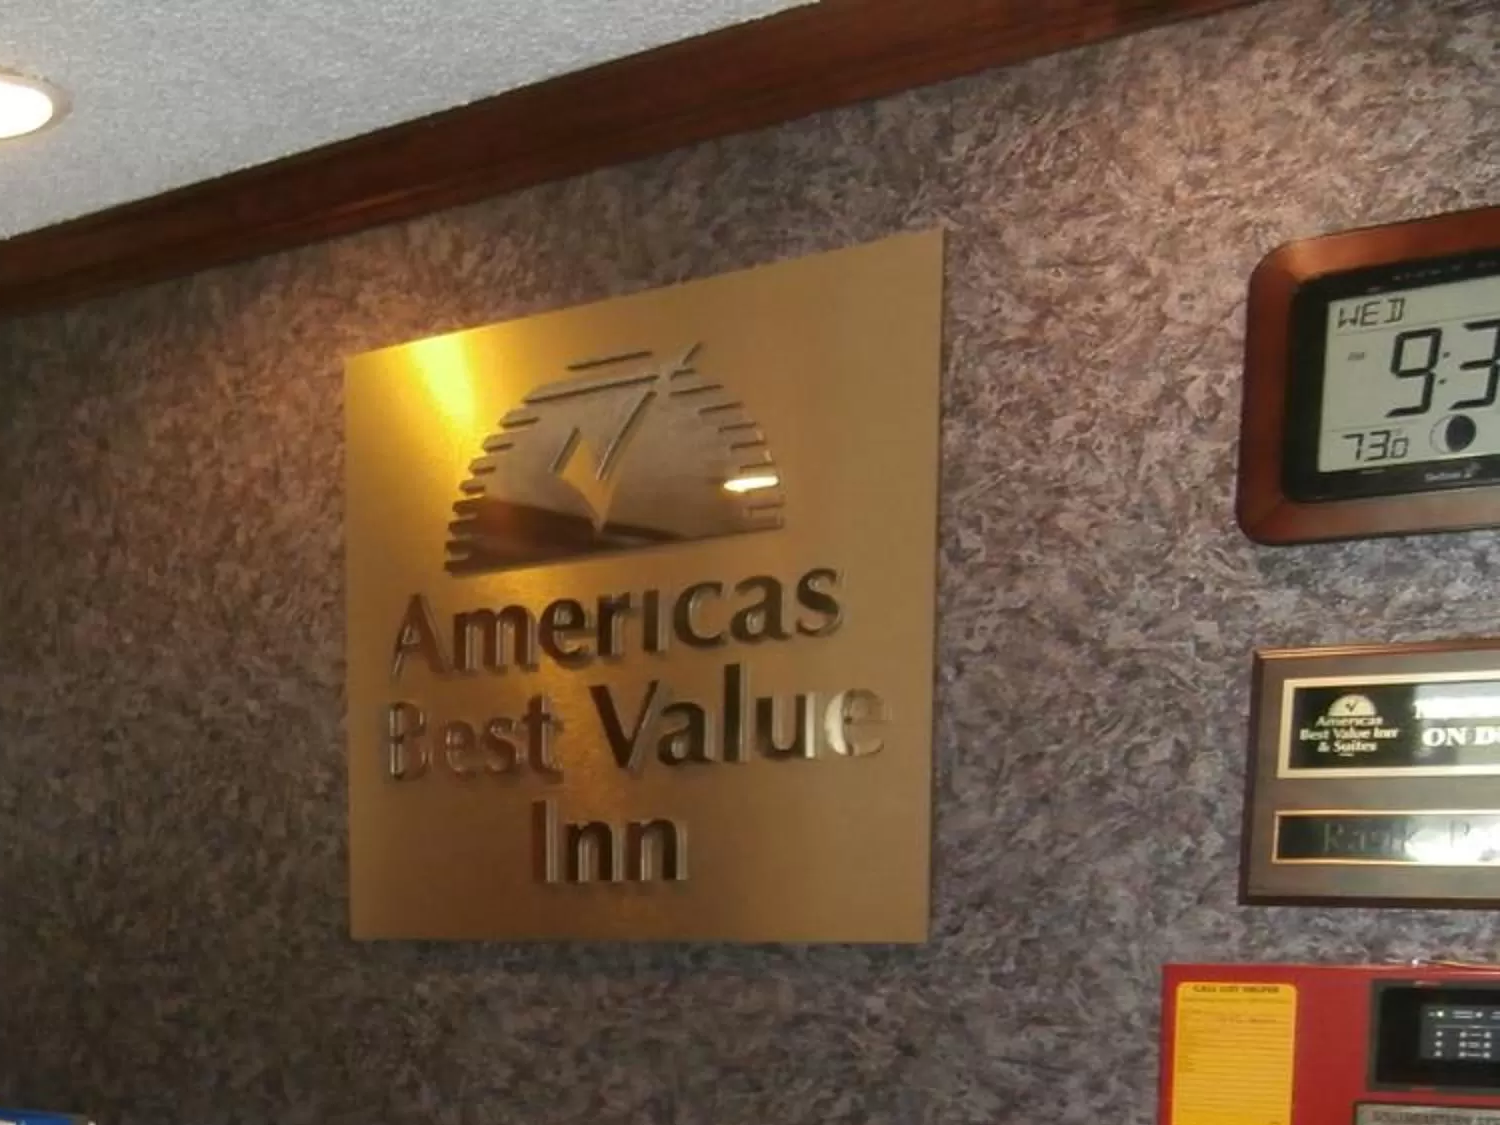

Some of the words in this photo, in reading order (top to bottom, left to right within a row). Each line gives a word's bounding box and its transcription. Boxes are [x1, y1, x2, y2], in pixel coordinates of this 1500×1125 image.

[1336, 297, 1406, 329] WED
[393, 566, 844, 677] Americas
[386, 693, 563, 783] Best
[589, 663, 888, 777] Value
[1300, 728, 1330, 741] Best
[1332, 727, 1371, 740] Value
[1422, 726, 1467, 747] ON
[1333, 740, 1378, 753] Suites
[530, 799, 691, 883] Inn
